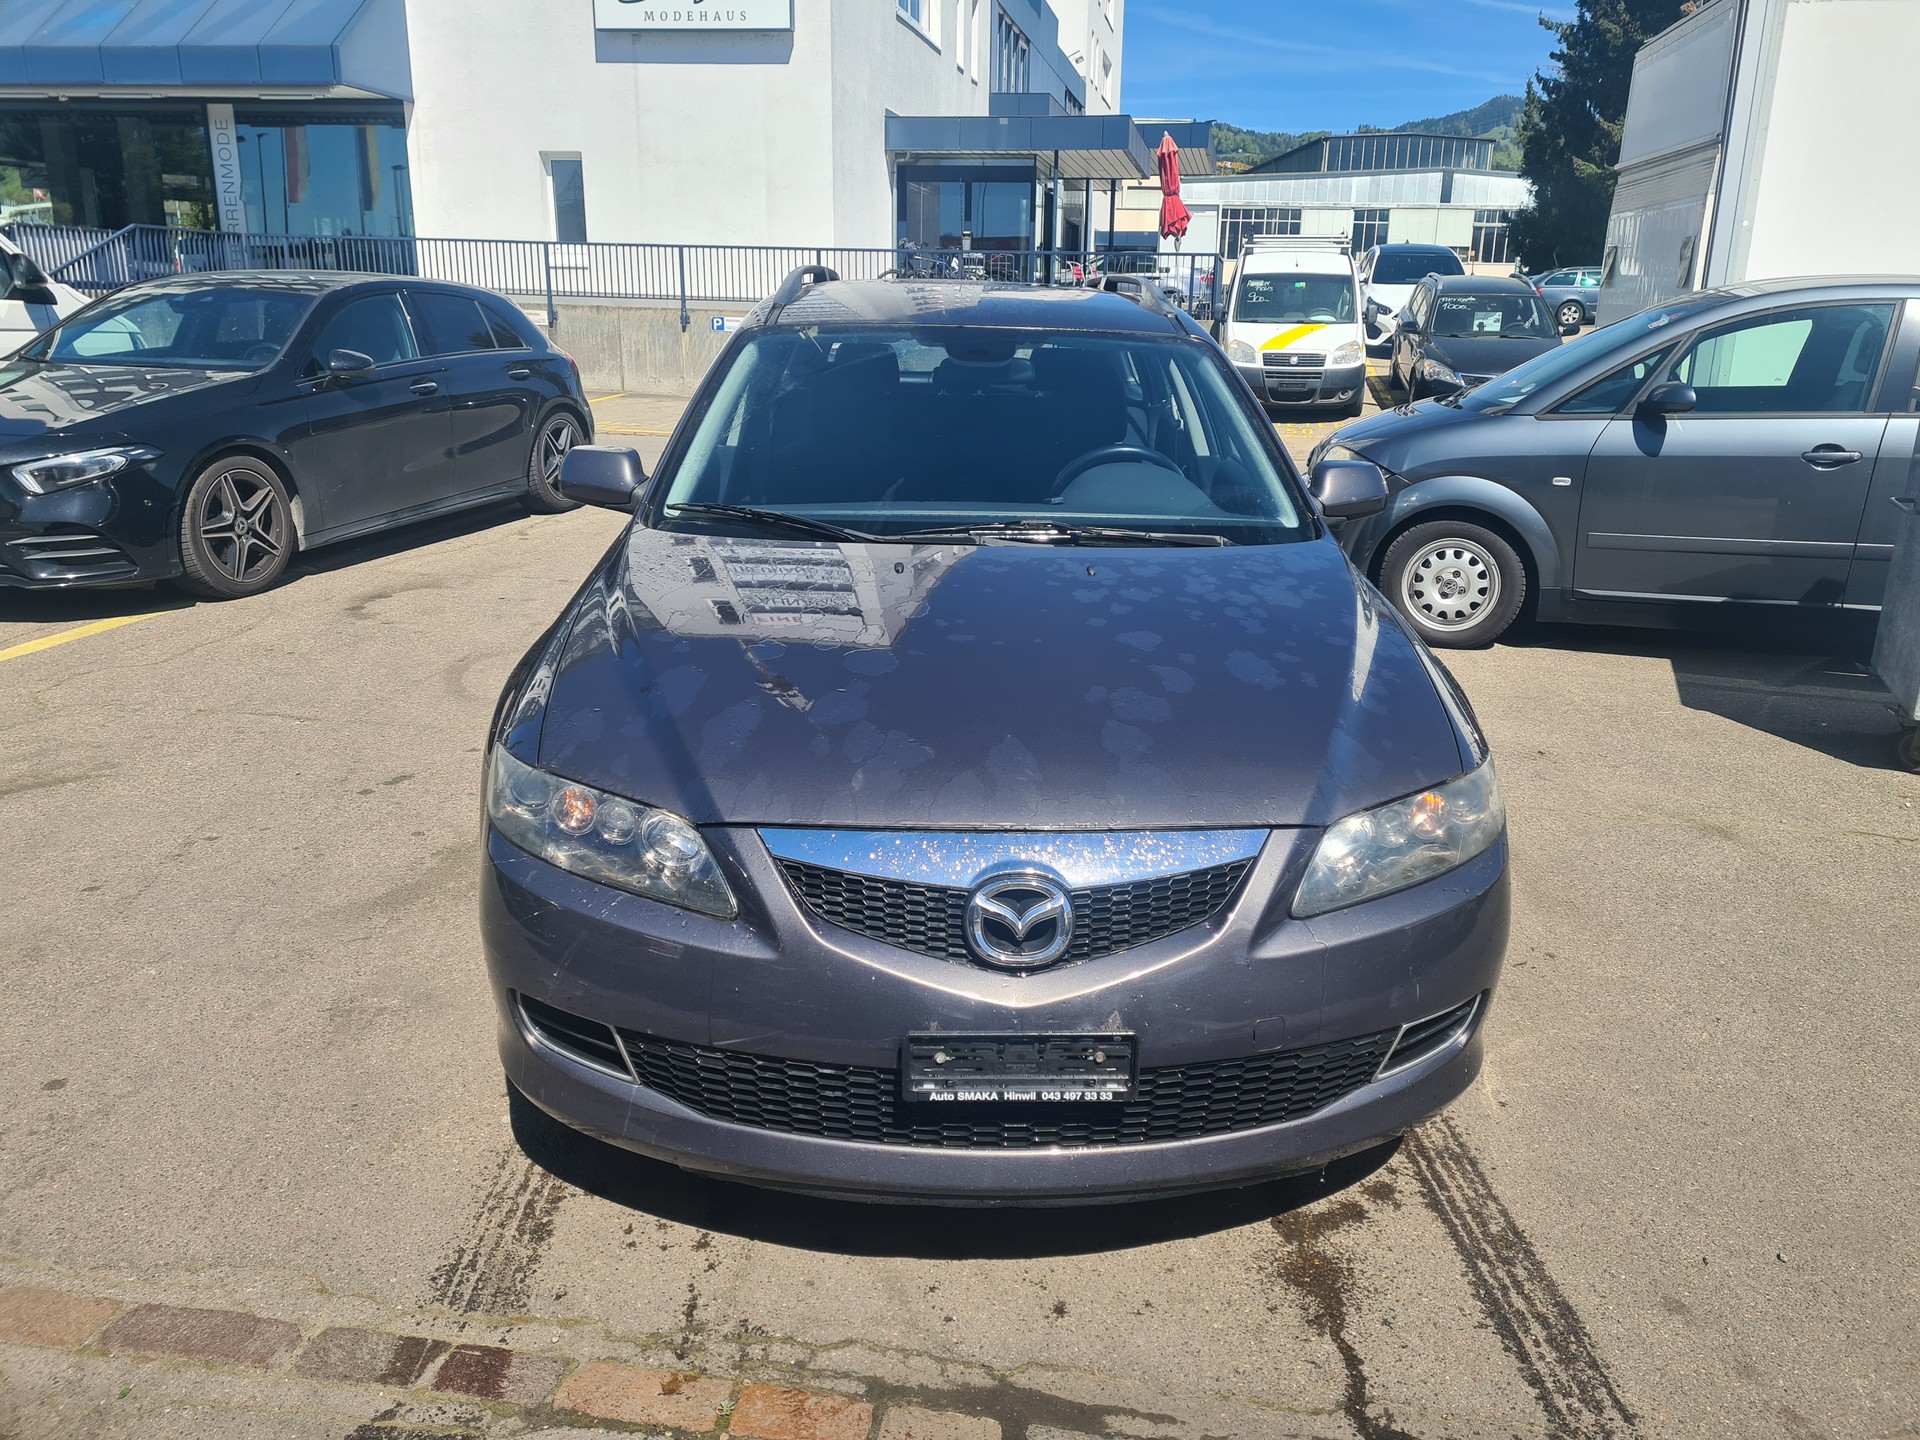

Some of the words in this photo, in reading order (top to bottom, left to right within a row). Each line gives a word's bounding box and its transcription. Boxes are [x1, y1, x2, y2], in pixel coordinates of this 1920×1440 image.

[643, 10, 747, 21] MODEHAUS
[713, 318, 723, 330] P
[929, 1091, 955, 1101] Auto
[957, 1091, 999, 1101] SMAKA
[1003, 1091, 1037, 1101] Hinwil
[1041, 1091, 1061, 1101] 043
[1063, 1091, 1082, 1101] 497
[1084, 1091, 1098, 1101] 33
[1099, 1091, 1113, 1101] 33
